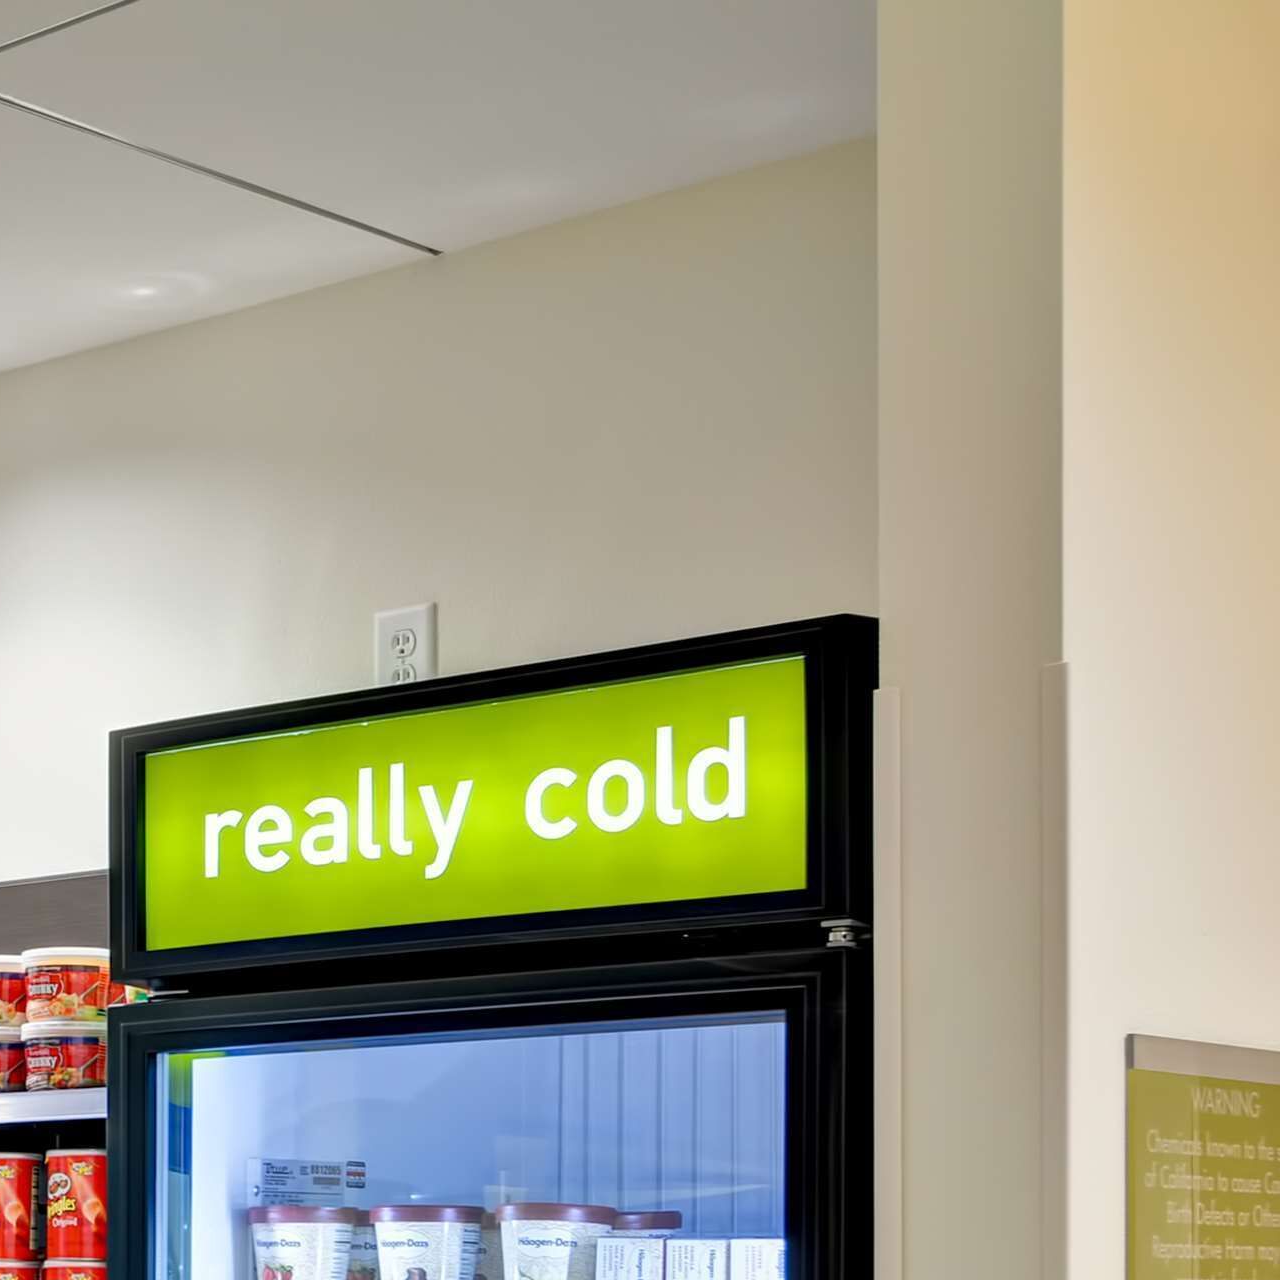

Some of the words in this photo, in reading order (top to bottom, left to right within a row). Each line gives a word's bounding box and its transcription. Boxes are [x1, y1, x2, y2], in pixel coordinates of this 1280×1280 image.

[202, 762, 474, 880] really
[524, 715, 746, 841] cold
[1191, 1086, 1261, 1118] WARNING
[1146, 1129, 1202, 1156] Chemicals
[1206, 1136, 1241, 1159] known
[1244, 1139, 1256, 1160] to
[1258, 1137, 1275, 1161] the
[1144, 1160, 1157, 1188] of
[1160, 1163, 1215, 1191] California
[1217, 1169, 1229, 1192] to
[1195, 1202, 1235, 1227] Defects
[1238, 1208, 1250, 1228] or
